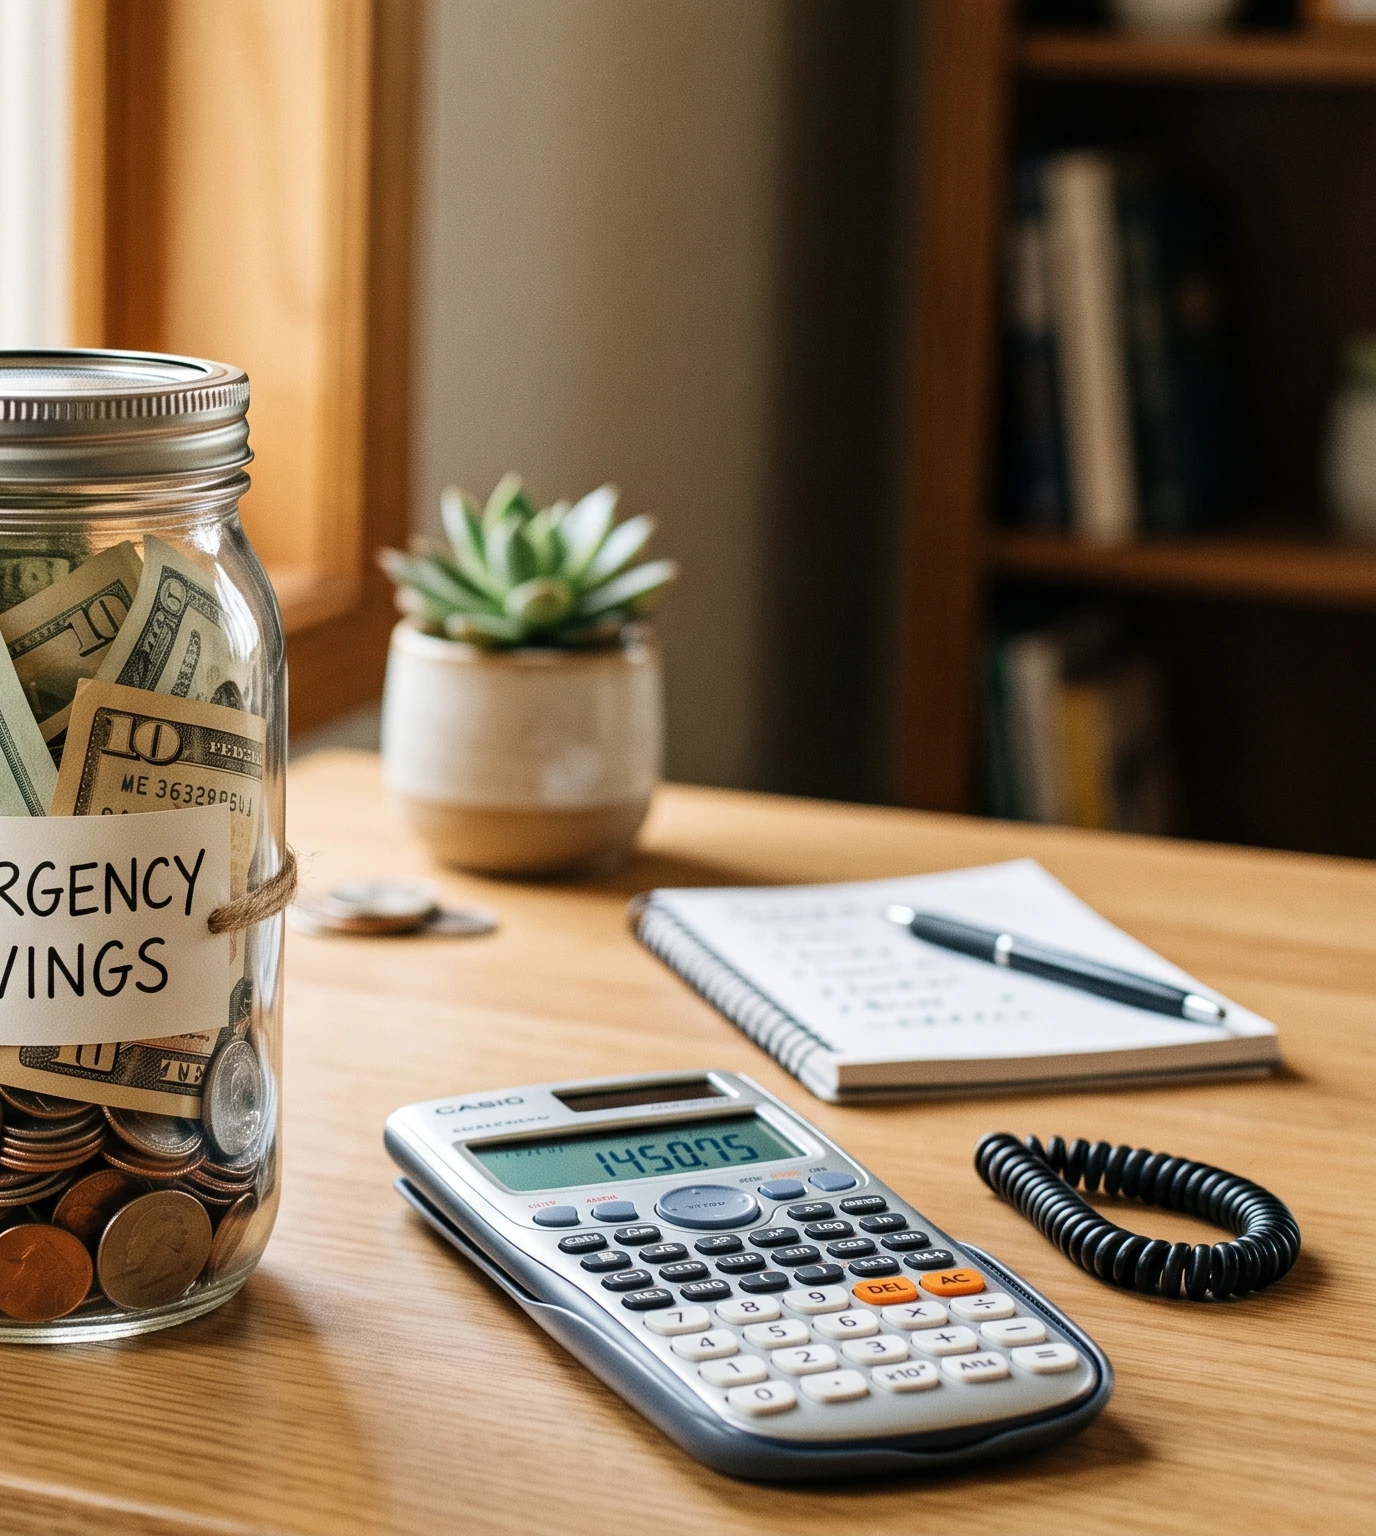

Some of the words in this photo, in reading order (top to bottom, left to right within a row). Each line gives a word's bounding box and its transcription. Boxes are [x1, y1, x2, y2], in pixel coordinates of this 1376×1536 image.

[66, 594, 124, 658] 10
[101, 714, 183, 766] 10
[120, 773, 150, 796] ME
[435, 1095, 525, 1116] CASIO
[867, 1282, 908, 1294] DEL
[941, 1273, 970, 1285] AC
[667, 1312, 684, 1323] 7
[741, 1301, 760, 1313] 8
[808, 1291, 826, 1303] 9
[700, 1337, 716, 1349] 4
[768, 1326, 787, 1338] 5
[839, 1316, 857, 1327] 6
[726, 1362, 741, 1373] 1
[795, 1351, 818, 1363] 2
[873, 1342, 886, 1353] 3
[754, 1388, 773, 1400] 0
